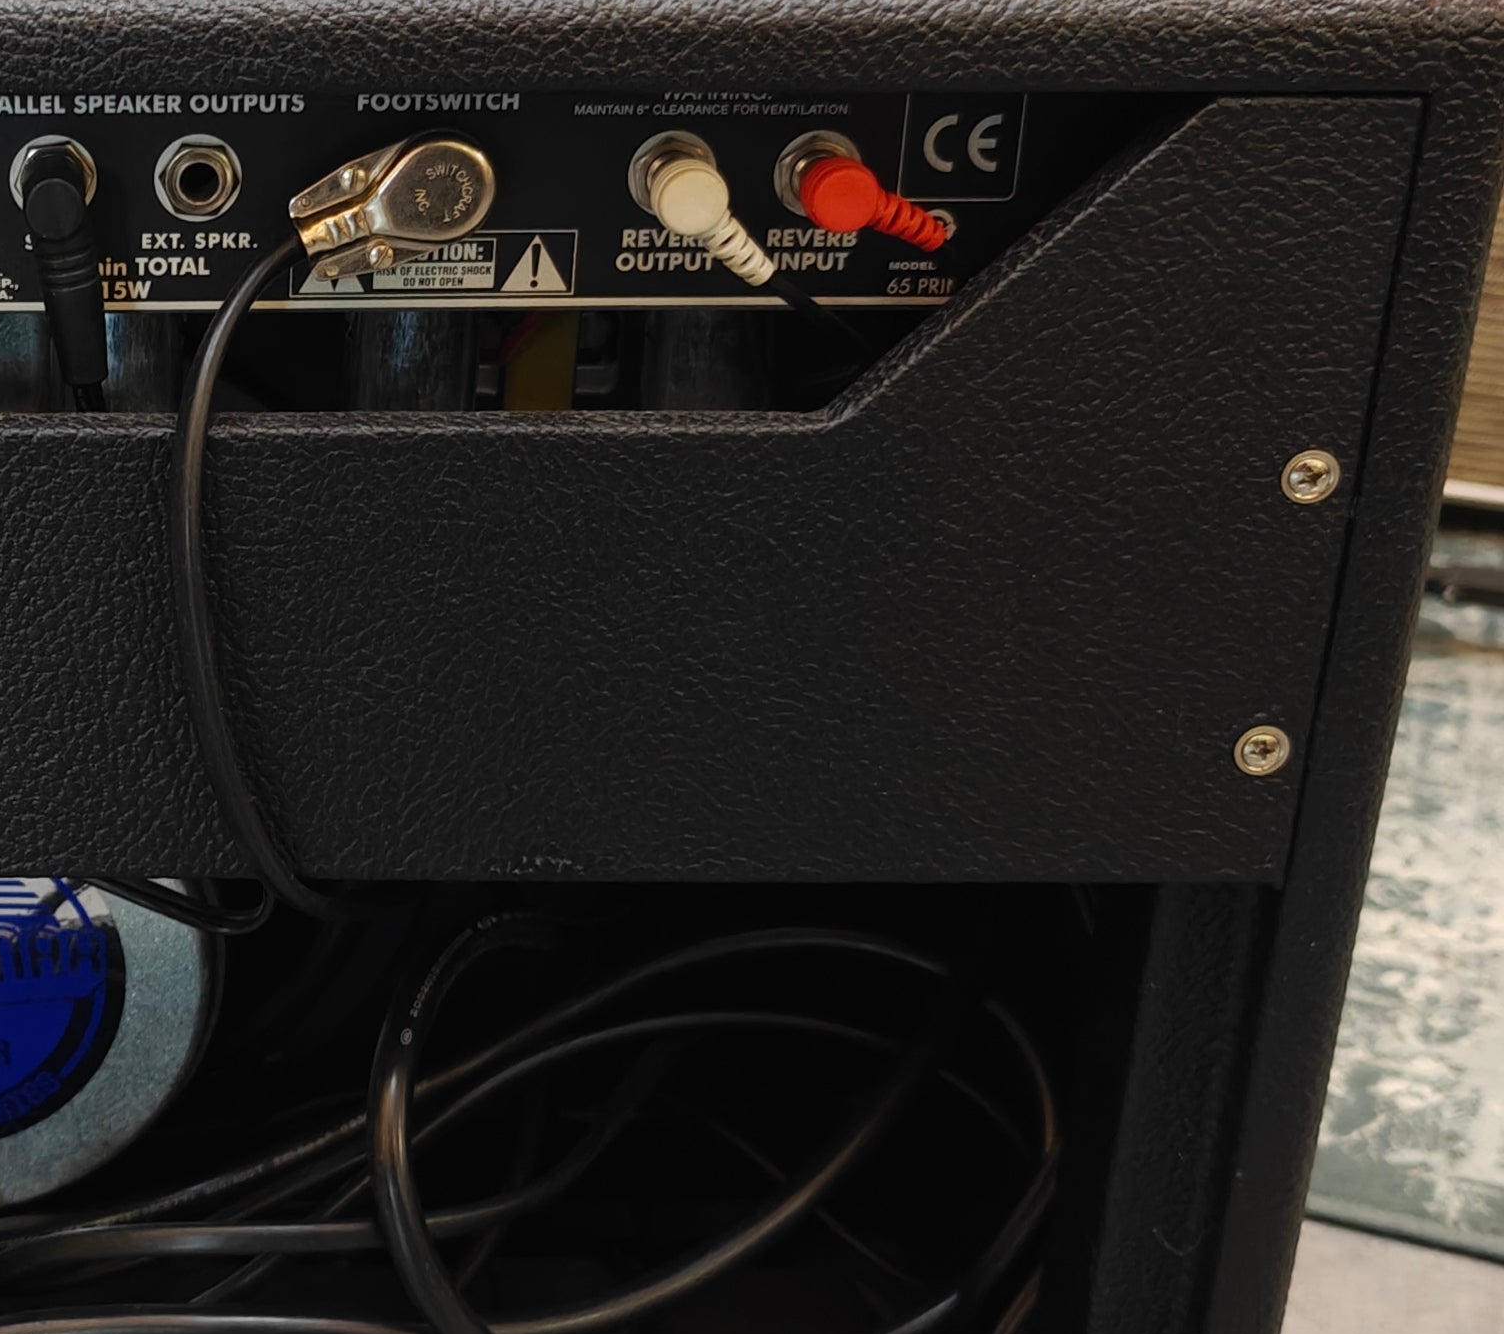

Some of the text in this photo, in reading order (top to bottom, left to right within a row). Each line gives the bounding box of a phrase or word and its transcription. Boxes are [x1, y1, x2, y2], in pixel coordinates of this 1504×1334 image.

[73, 95, 181, 114] SPEAKER
[190, 94, 305, 114] OUTPUTS
[356, 93, 520, 111] FOOTSWITCH
[574, 105, 634, 115] MAINTAIN
[653, 104, 728, 115] CLEARANCE
[733, 104, 760, 115] FOR
[762, 104, 848, 115] VENTILATION
[426, 164, 474, 223] SWITCHCRAFT
[141, 233, 258, 249] EXT. SPKR.
[767, 228, 857, 247] REVERB
[135, 257, 210, 276] TOTAL
[376, 266, 491, 276] RISK OF ELECTRIC SHOCK
[616, 252, 713, 272] OUTPUT
[774, 253, 847, 271] INPUT
[888, 261, 937, 271] MODEL
[101, 280, 152, 300] 15W
[403, 277, 463, 287] DO NOT OPEN
[887, 278, 911, 295] 65
